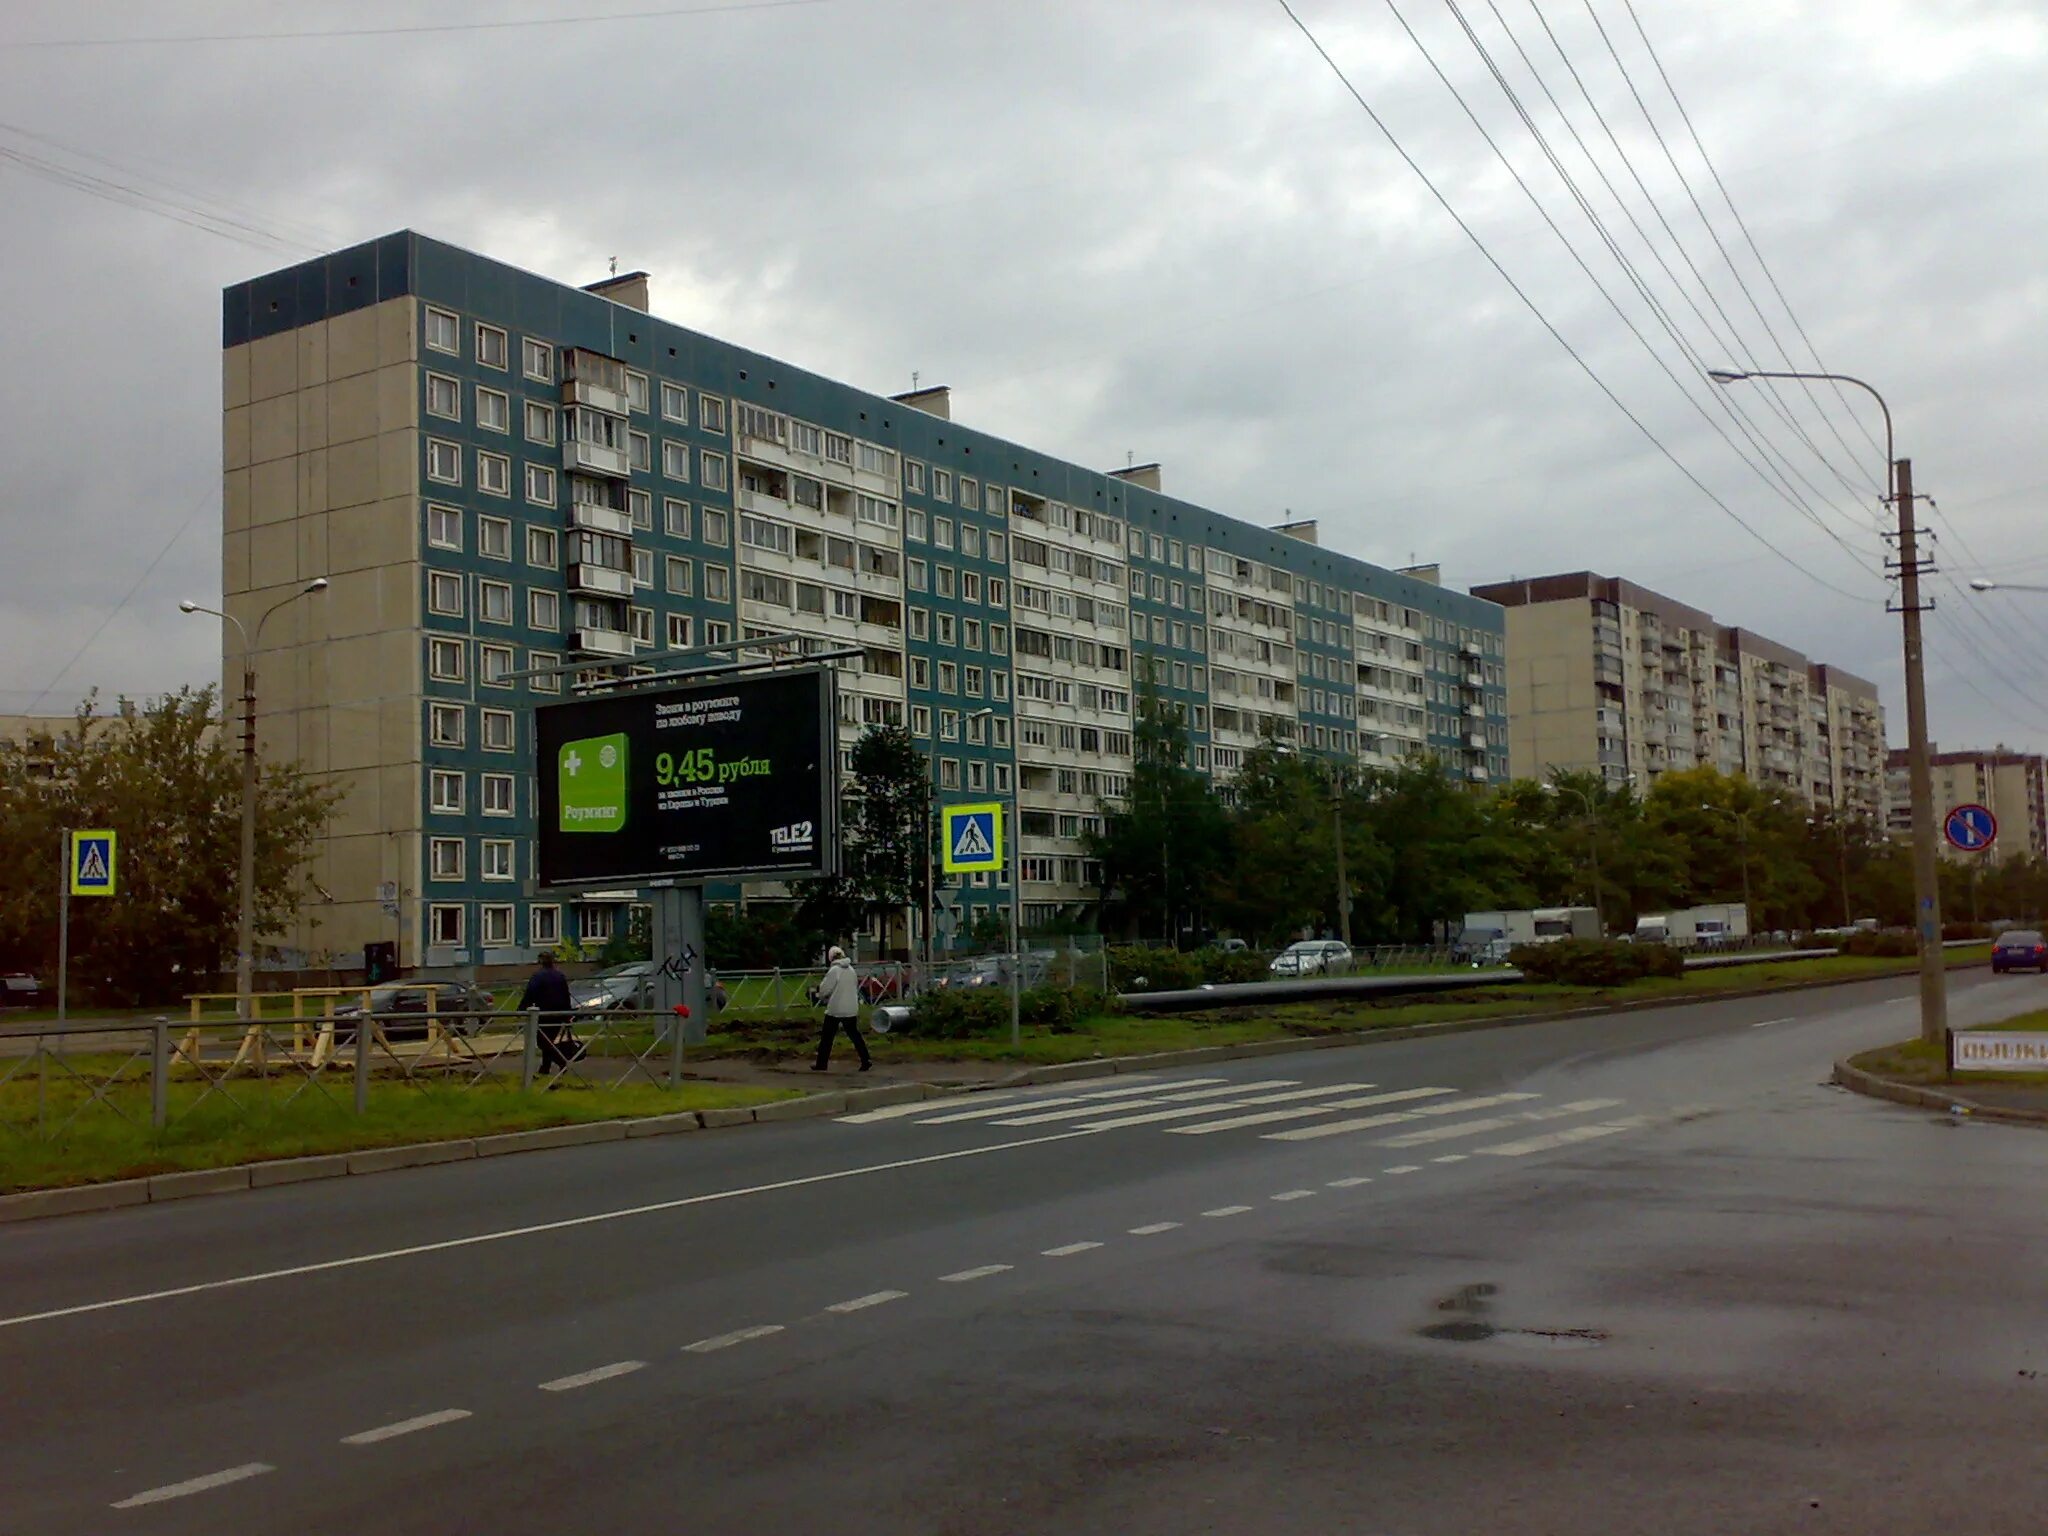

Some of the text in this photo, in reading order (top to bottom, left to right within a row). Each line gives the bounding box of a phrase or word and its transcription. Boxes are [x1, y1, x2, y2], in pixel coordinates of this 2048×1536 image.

[685, 702, 691, 712] в
[692, 696, 740, 713] роуминге
[656, 748, 771, 788] 9,45 рубля
[565, 805, 618, 821] Роуминг
[770, 821, 813, 845] TELE2
